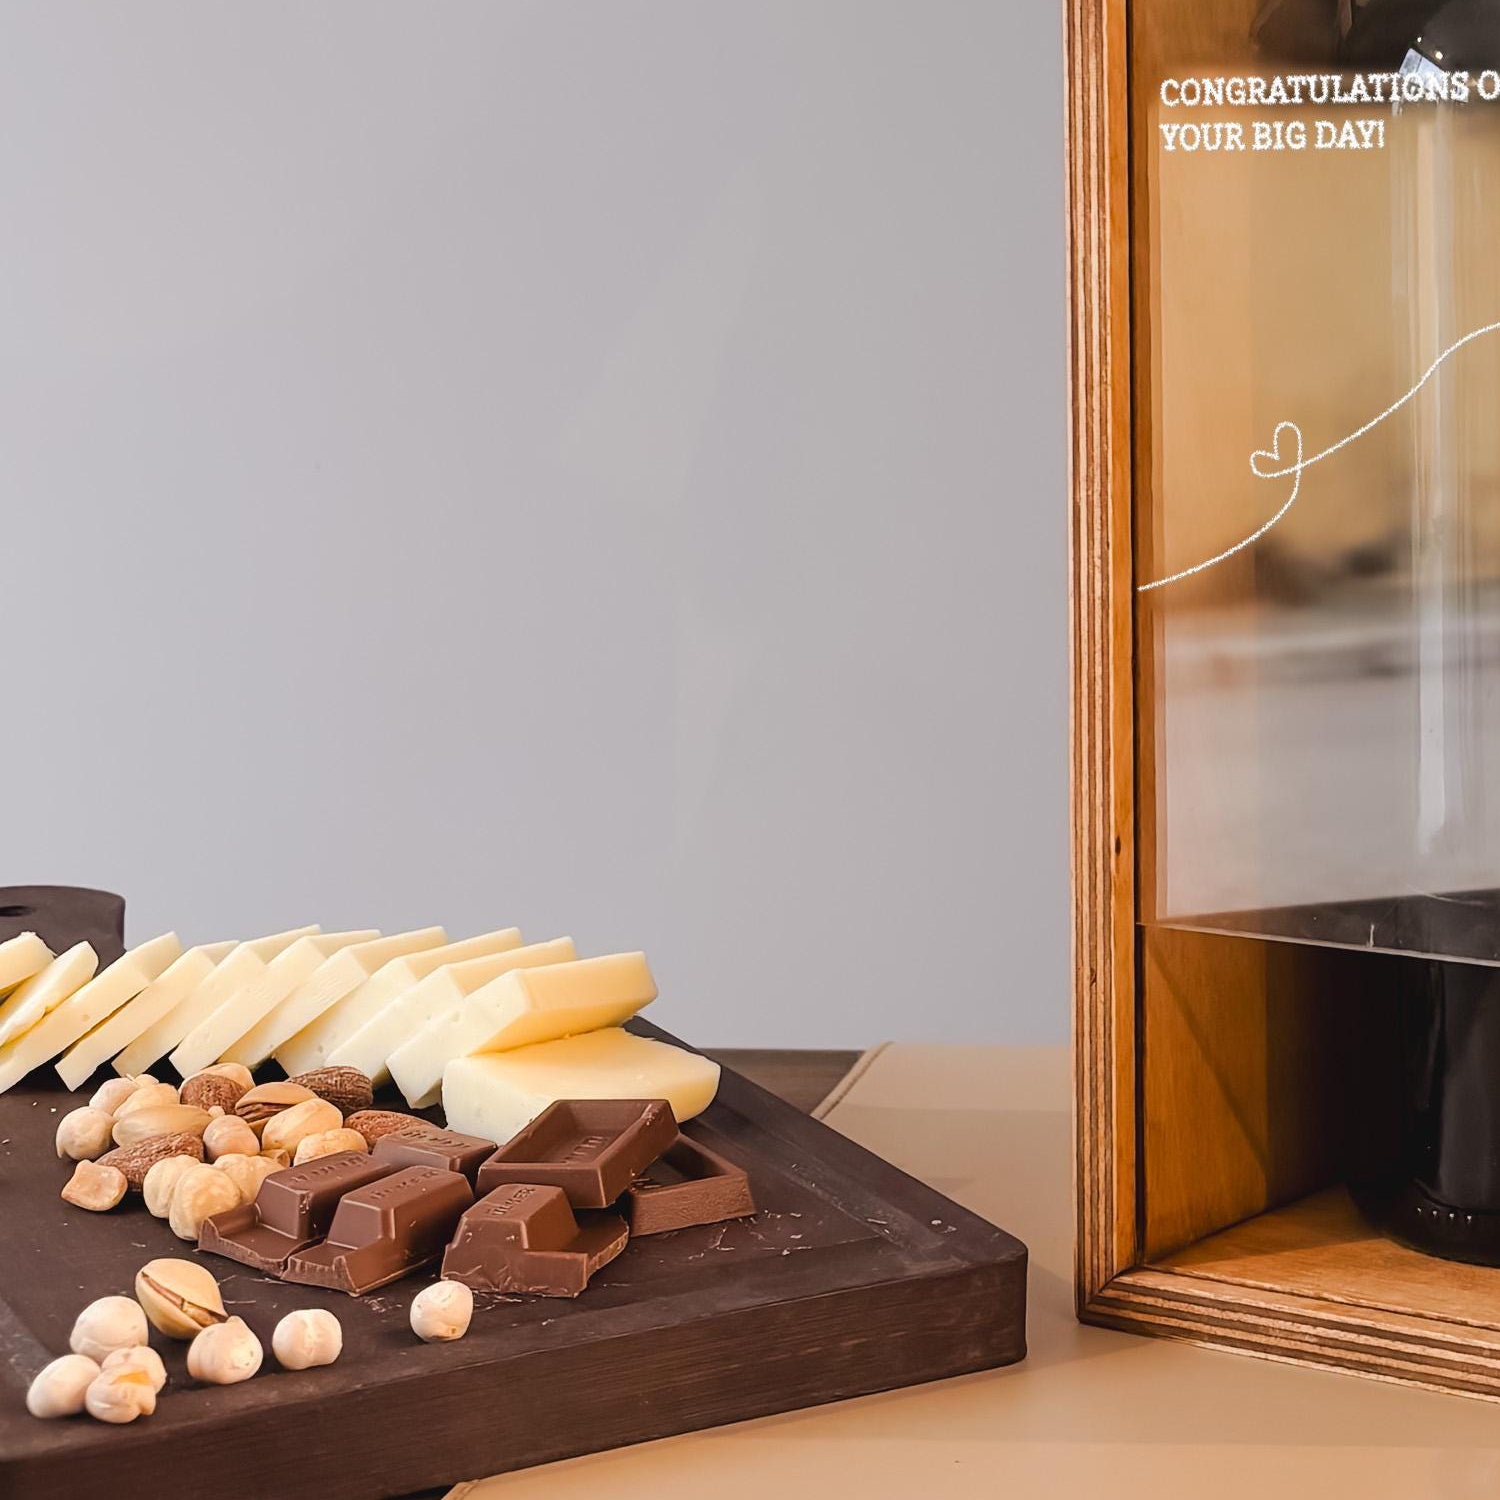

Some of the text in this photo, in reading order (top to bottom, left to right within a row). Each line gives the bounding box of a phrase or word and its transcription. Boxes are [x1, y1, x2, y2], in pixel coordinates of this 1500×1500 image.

[1159, 70, 1470, 106] CONGRATULATIONS
[1159, 118, 1385, 152] YOUR BIG DAY!
